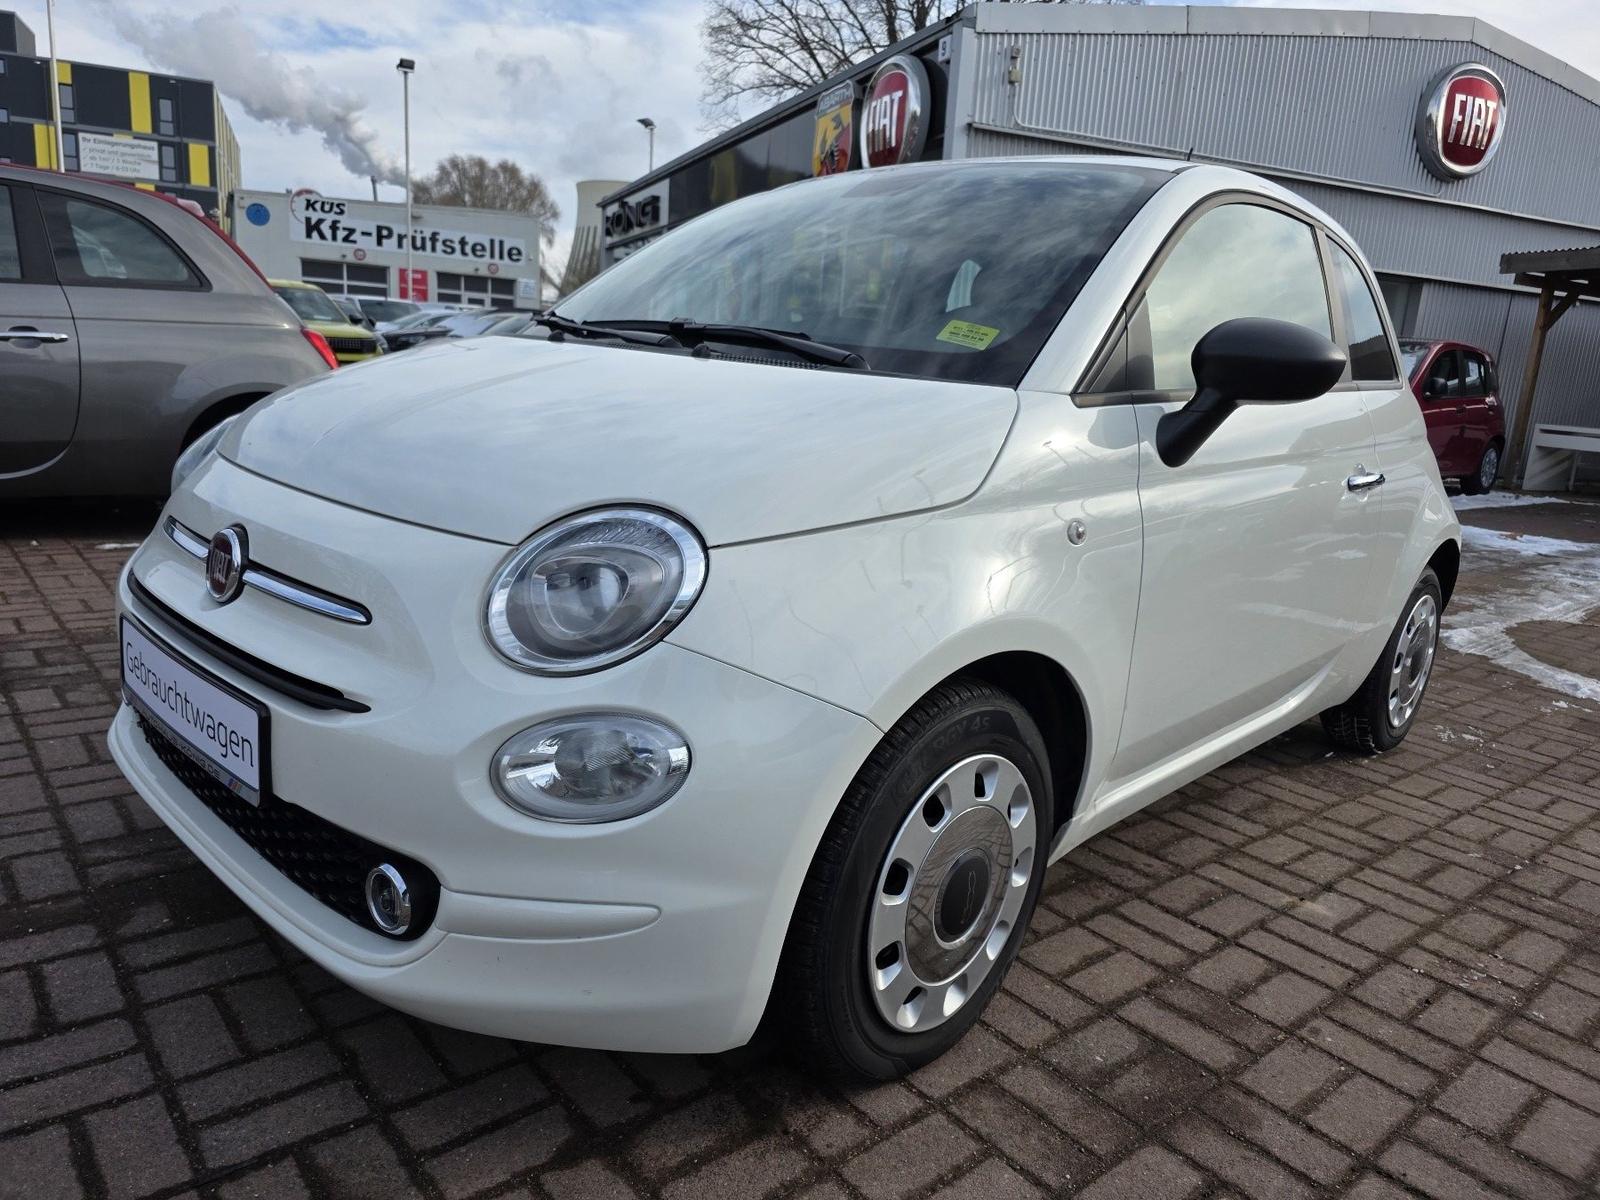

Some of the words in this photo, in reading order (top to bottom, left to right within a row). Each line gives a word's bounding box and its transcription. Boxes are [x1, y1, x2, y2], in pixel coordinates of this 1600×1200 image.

[867, 89, 904, 154] FIAT
[1447, 93, 1498, 150] FIAT
[304, 198, 346, 216] KÜS
[304, 217, 523, 262] Kfz-Prüfstelle
[126, 641, 254, 768] Gebrauchtwagen
